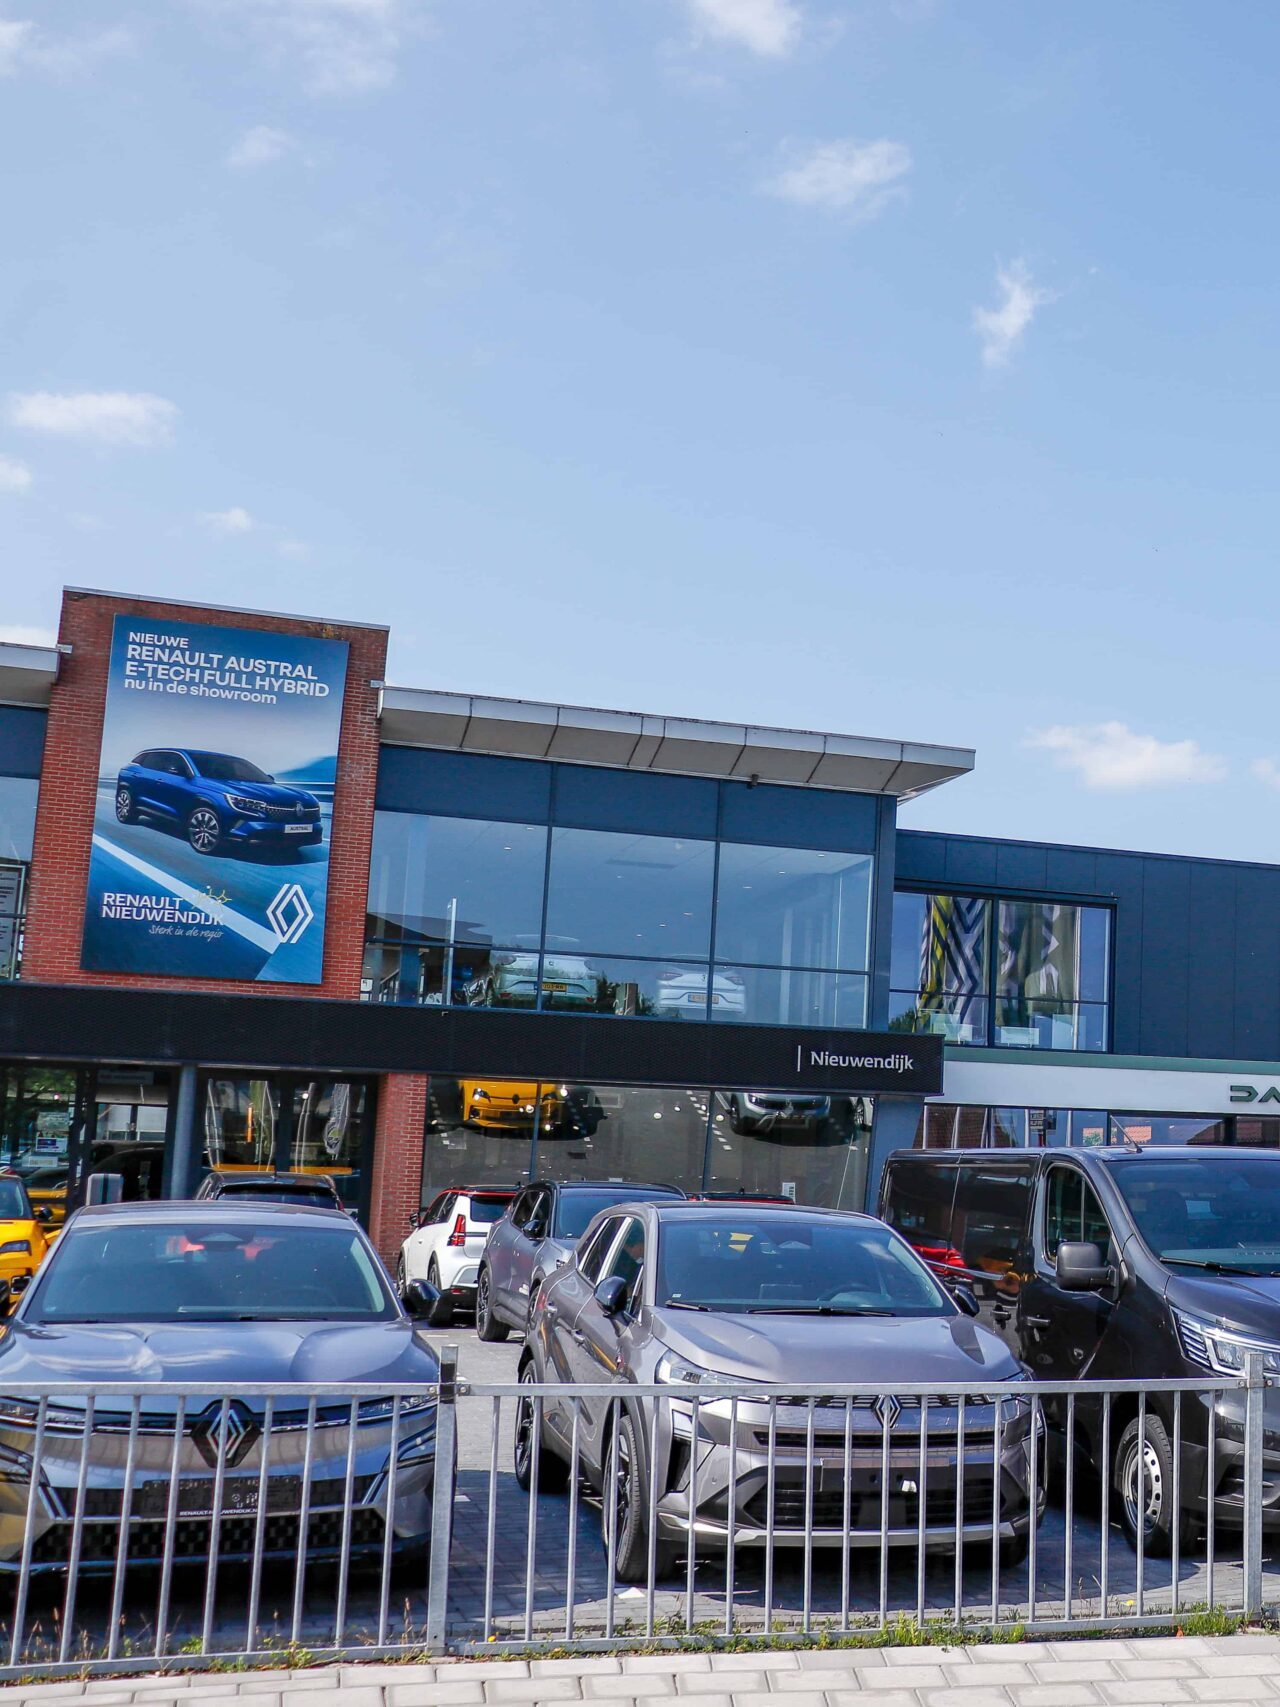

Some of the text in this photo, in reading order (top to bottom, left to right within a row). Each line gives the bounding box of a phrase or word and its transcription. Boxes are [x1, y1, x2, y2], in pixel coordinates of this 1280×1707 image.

[129, 631, 189, 648] NIEUWE
[127, 644, 319, 681] RENAULT AUSTRAL
[125, 661, 330, 697] E-TECH FULL HYBRID
[124, 678, 277, 704] nu in de showroom
[103, 892, 183, 910] RENAULT
[102, 905, 224, 926] NIEUWENDIJK
[200, 931, 224, 942] regio
[811, 1051, 914, 1073] Nieuwendijk
